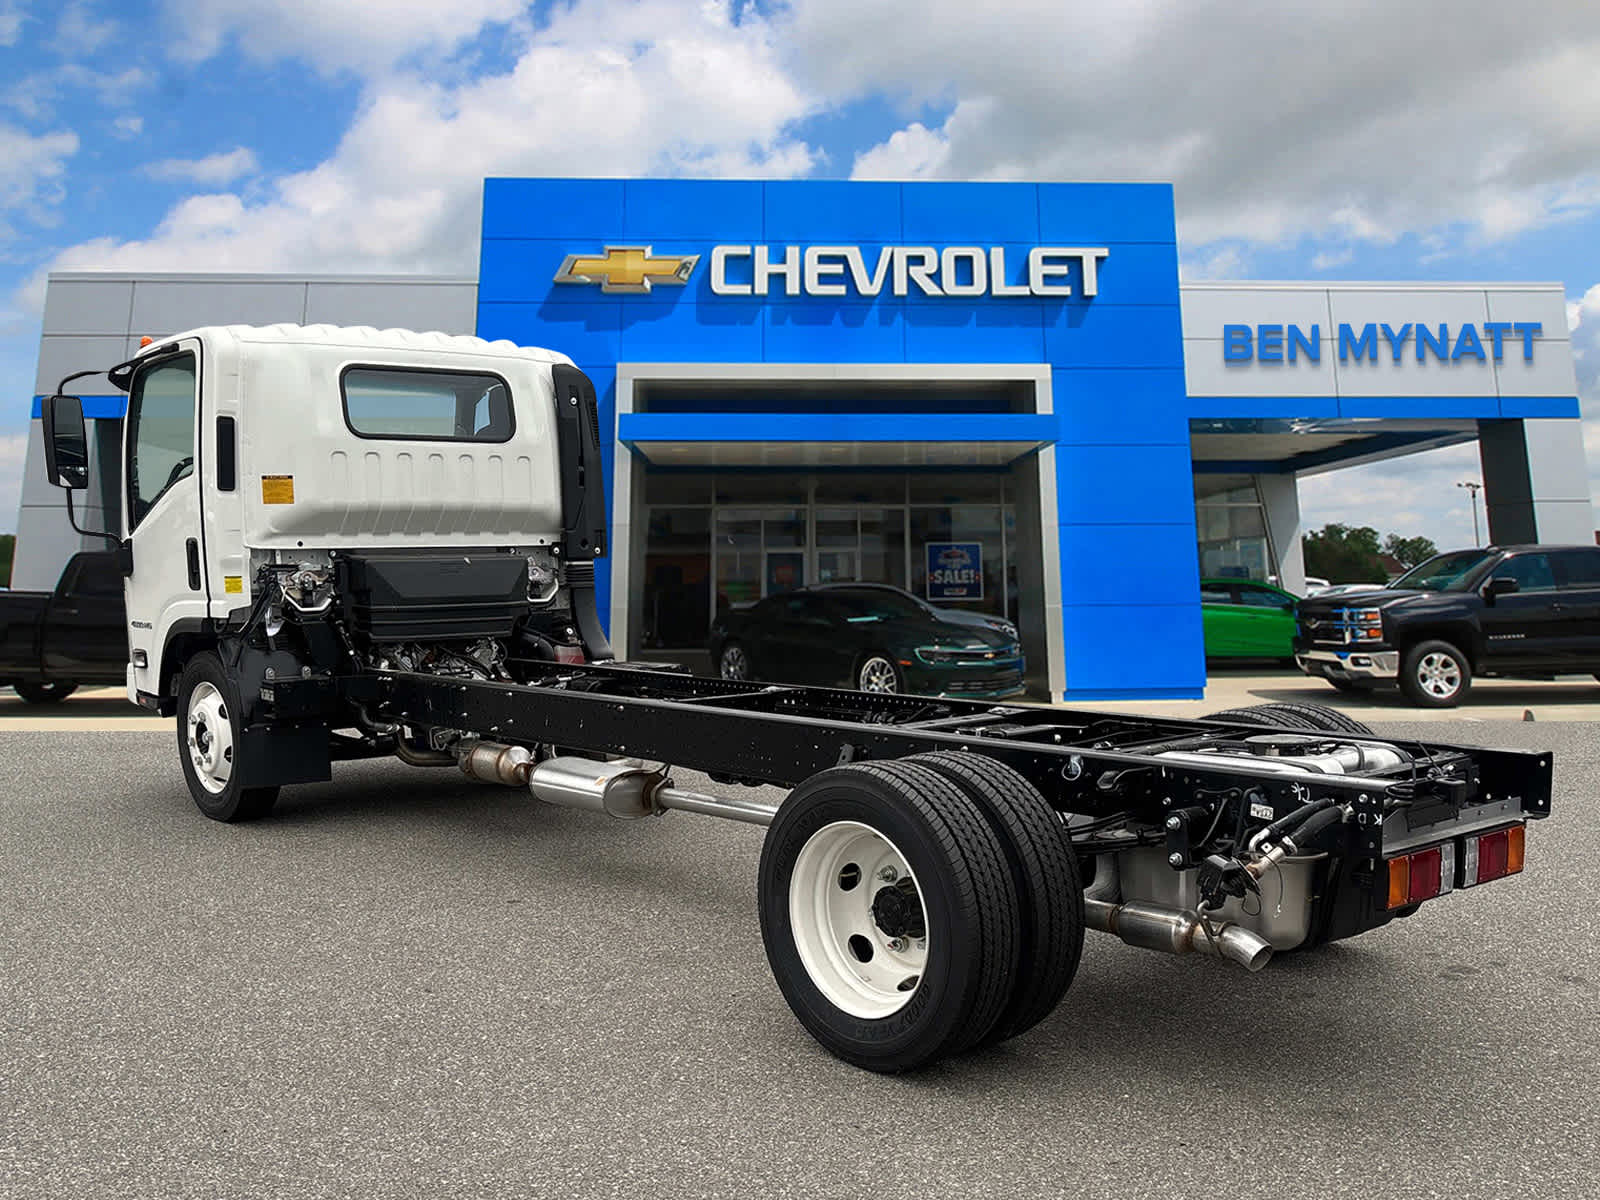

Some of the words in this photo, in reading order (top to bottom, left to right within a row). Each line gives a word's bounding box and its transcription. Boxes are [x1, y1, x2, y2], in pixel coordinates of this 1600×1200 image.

[710, 245, 1109, 297] CHEVROLET
[1223, 324, 1320, 362] BEN
[1338, 322, 1543, 362] MYNATT
[934, 569, 975, 585] SALE!
